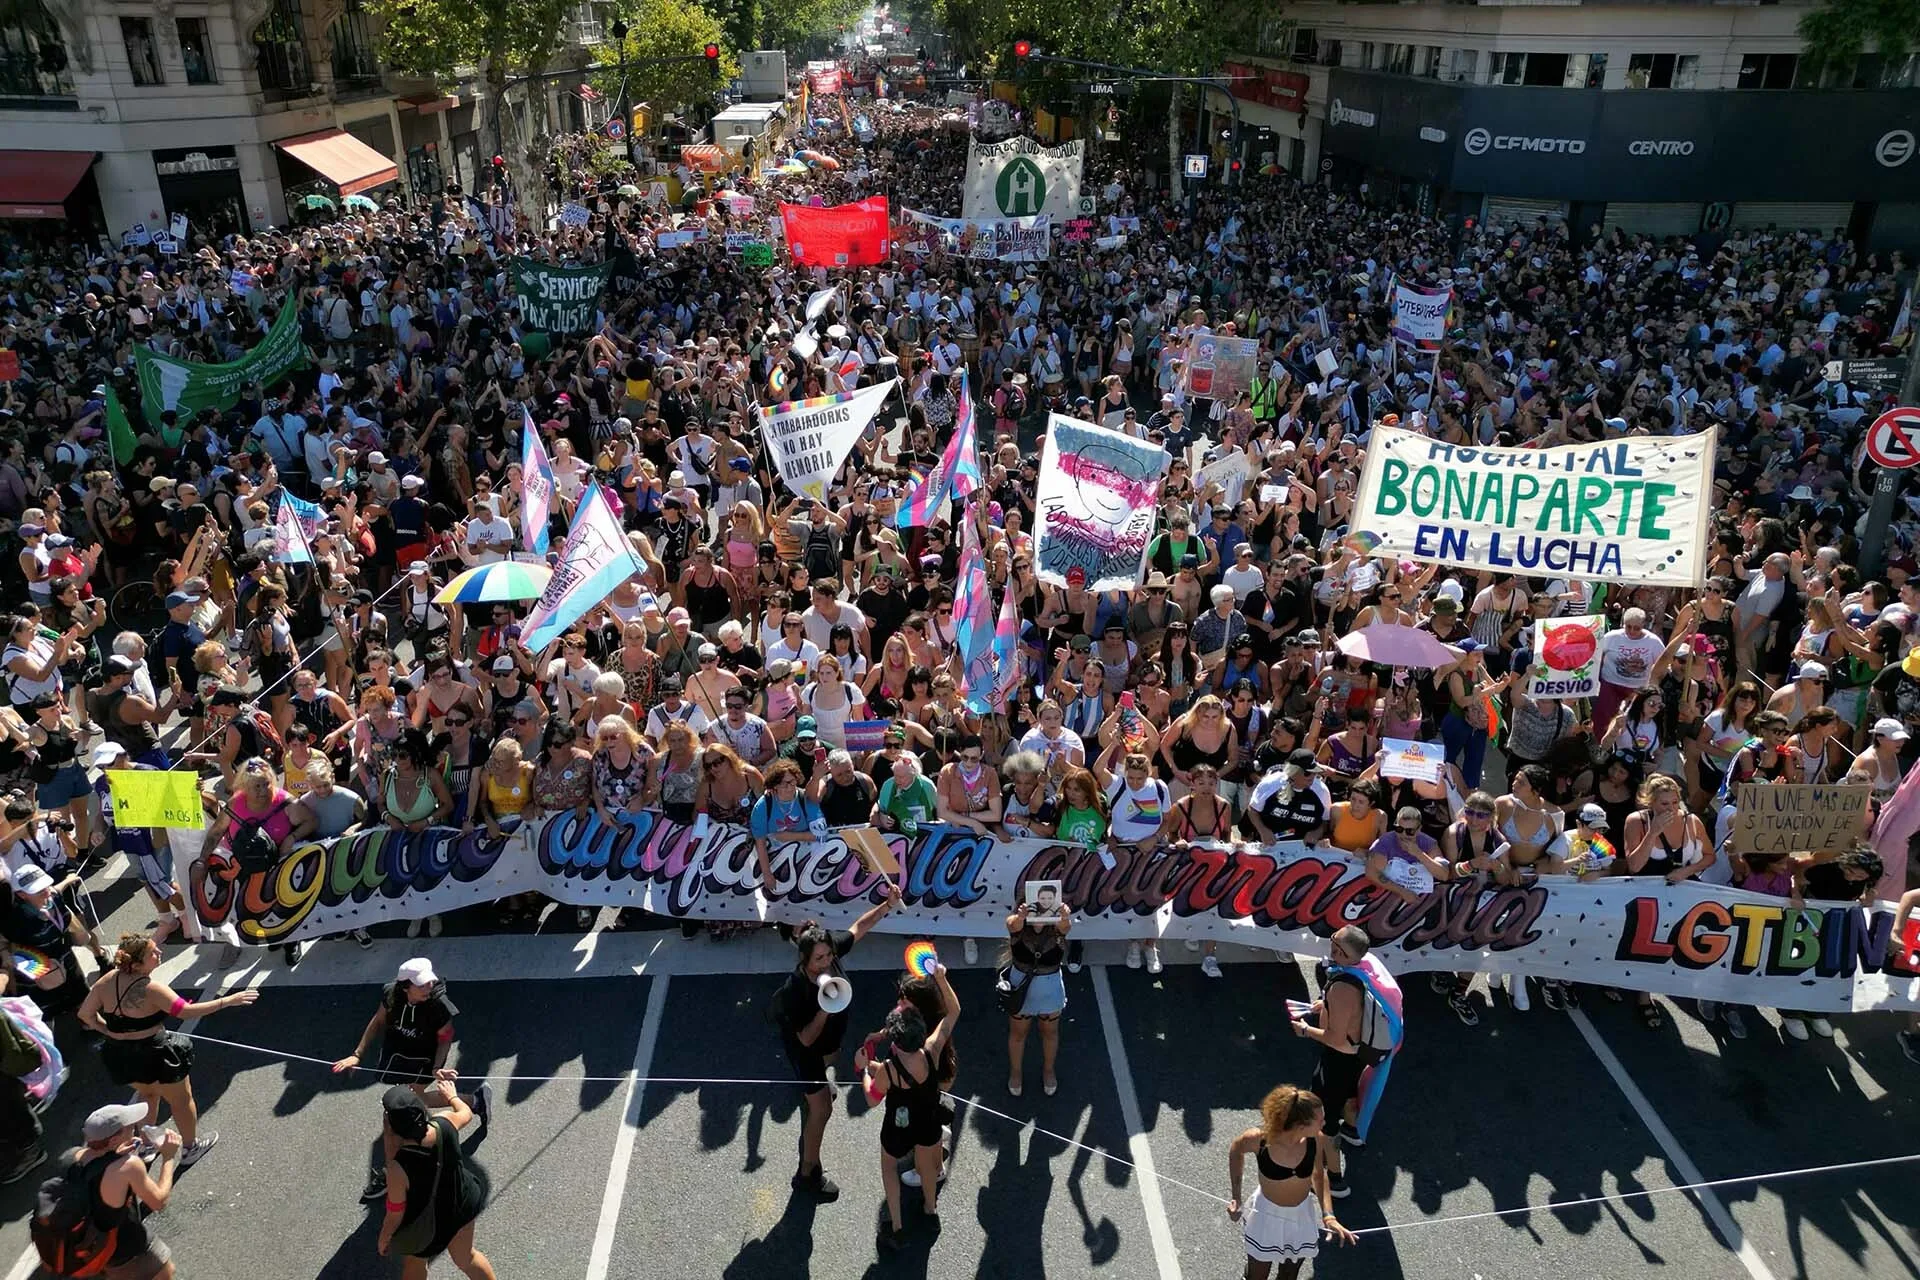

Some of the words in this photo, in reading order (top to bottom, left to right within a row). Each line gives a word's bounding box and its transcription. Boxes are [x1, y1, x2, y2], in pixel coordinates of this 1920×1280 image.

[1090, 85, 1114, 93] LIMA
[1493, 135, 1586, 154] CFMOTO
[1628, 140, 1695, 156] CENTRO
[995, 218, 1046, 243] Ballroom
[539, 272, 599, 300] SERVICIO
[776, 407, 850, 437] TRABAJADORXS
[783, 439, 796, 456] NO
[799, 433, 823, 452] HAY
[784, 450, 834, 481] MEMORIA
[1375, 458, 1676, 540] BONAPARTE
[1414, 524, 1469, 562] EN
[1488, 532, 1622, 576] LUCHA
[1534, 679, 1594, 695] DESVIO
[1774, 787, 1808, 812] UNE
[1834, 815, 1854, 830] DE
[1753, 832, 1839, 852] CALLE
